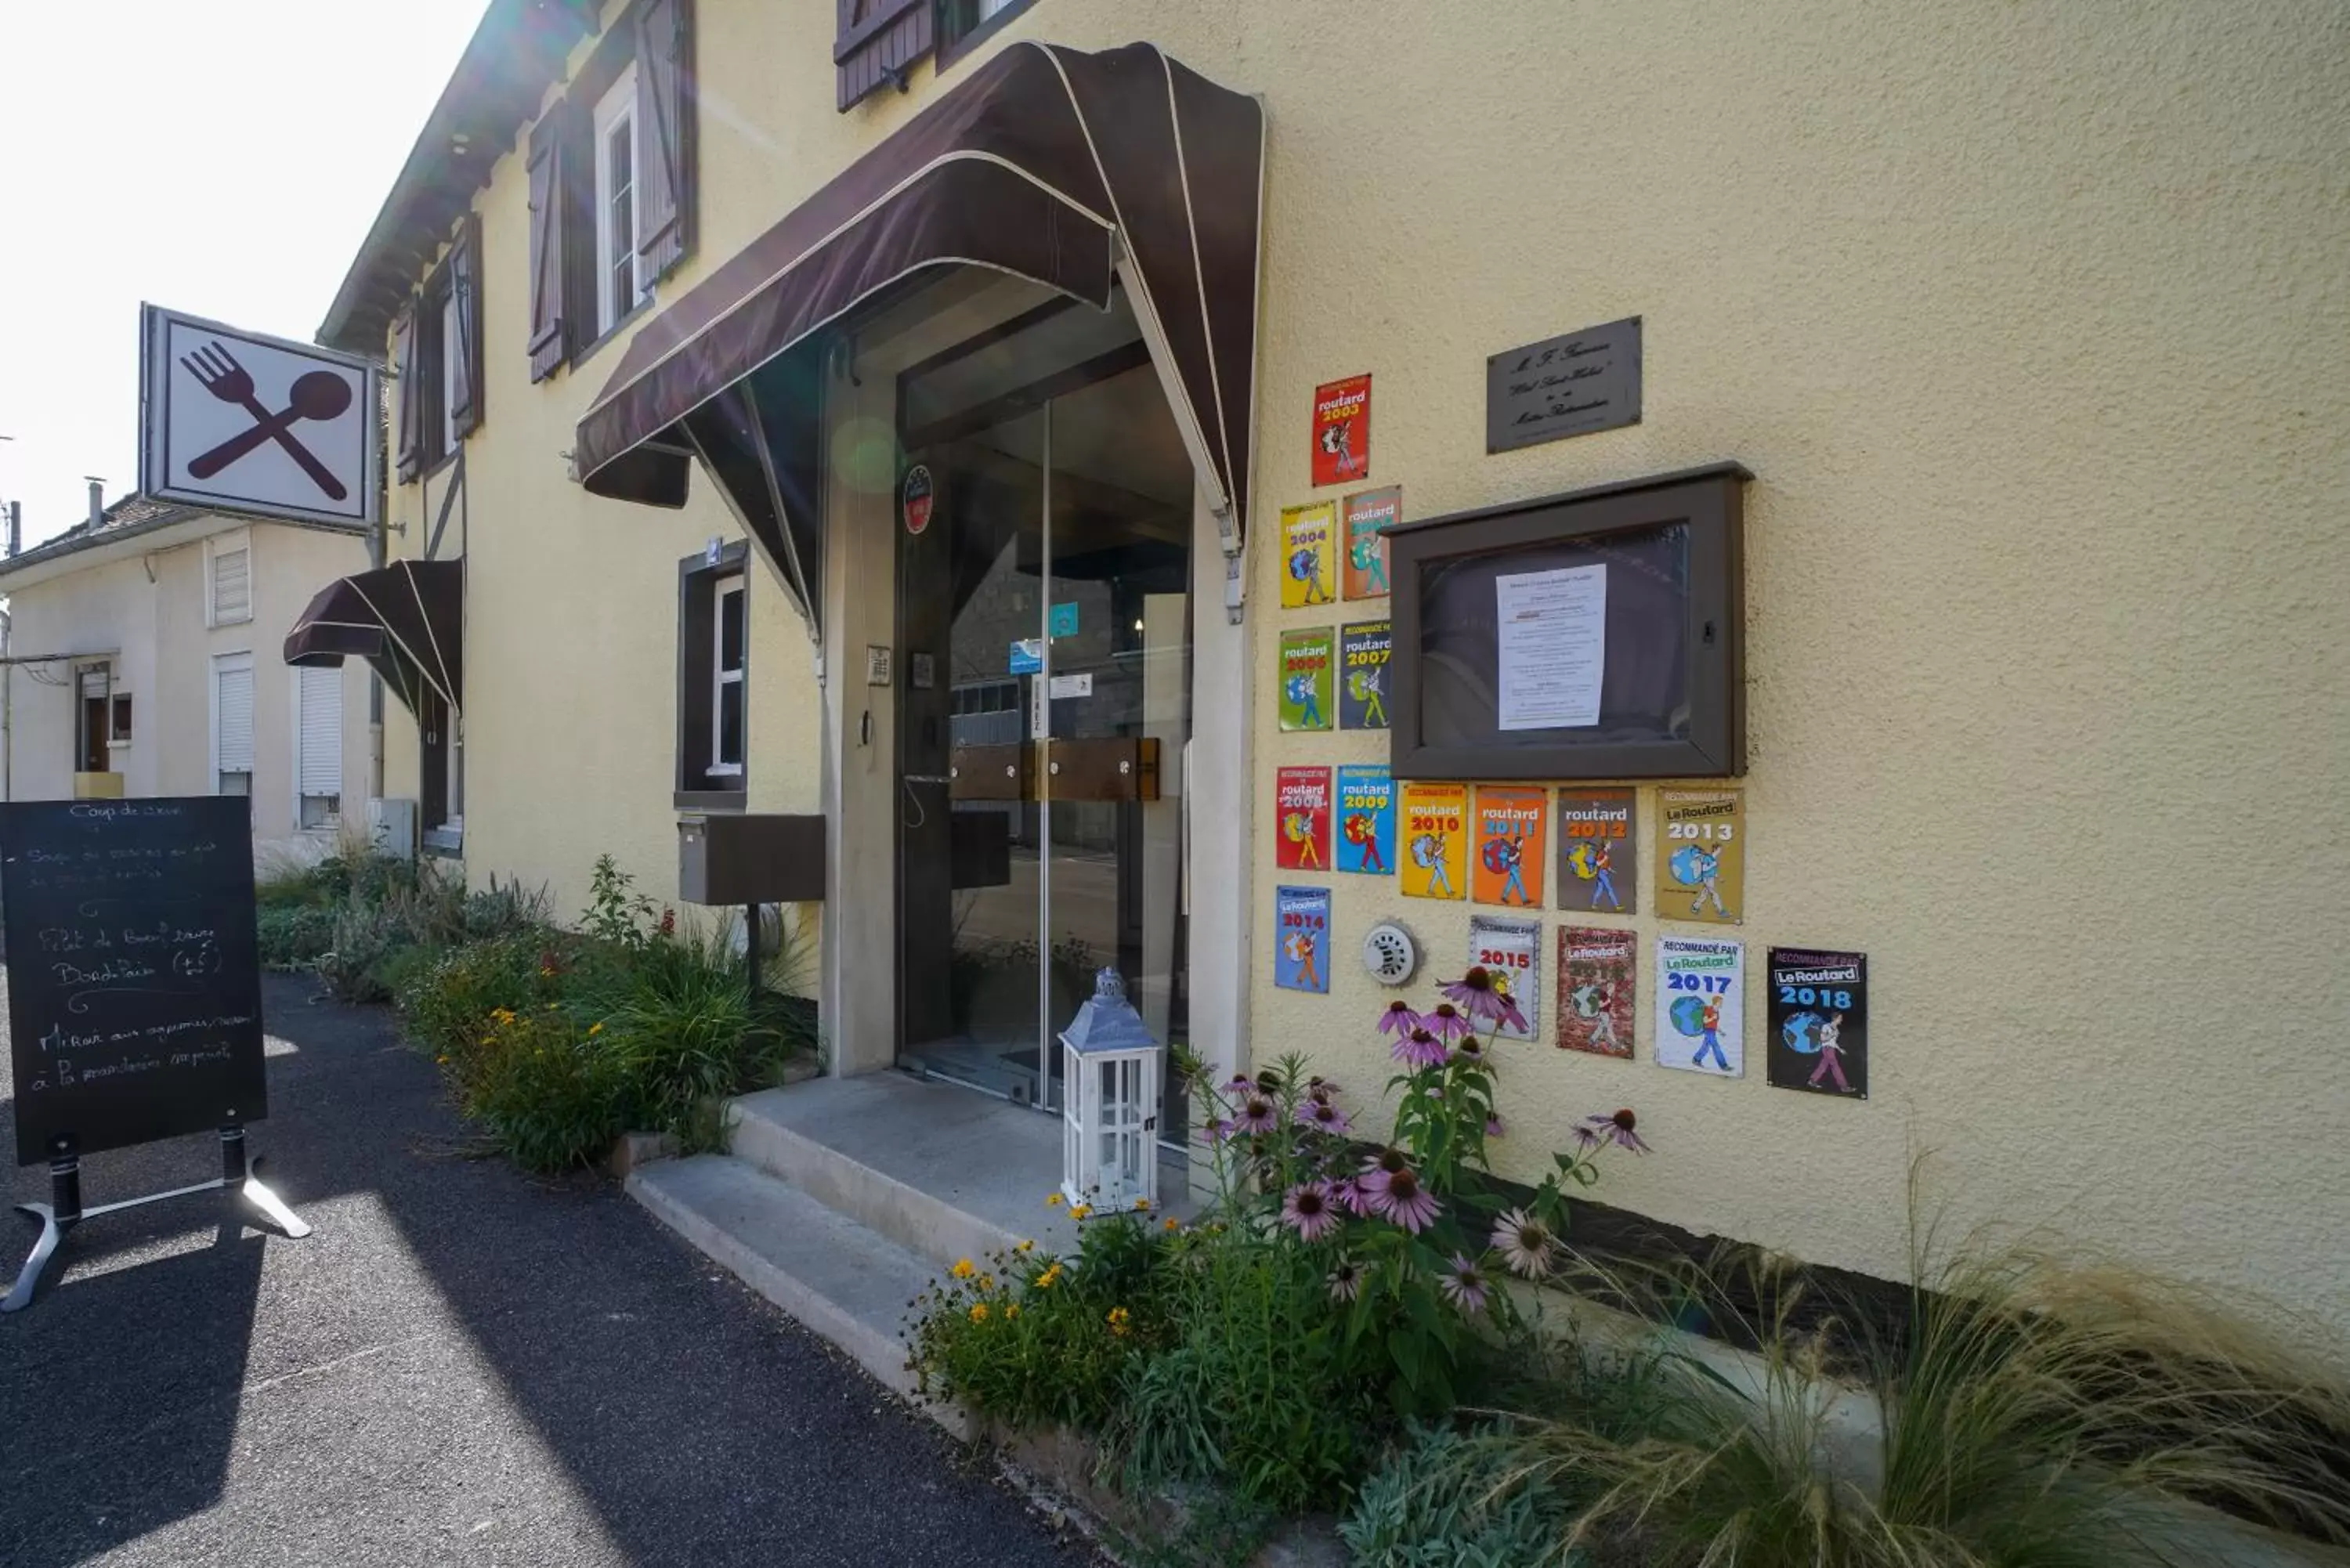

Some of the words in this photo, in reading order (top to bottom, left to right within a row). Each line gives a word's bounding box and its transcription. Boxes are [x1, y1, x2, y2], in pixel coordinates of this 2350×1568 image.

[1319, 390, 1366, 412] routard
[1322, 404, 1359, 421] 2003
[1348, 504, 1394, 522] routard
[1286, 515, 1329, 533] routard
[1290, 529, 1326, 547] 2004
[1285, 644, 1327, 658] routard
[1347, 638, 1392, 652] routard
[1347, 649, 1391, 666] 2007
[1282, 783, 1324, 795] routard
[1343, 783, 1390, 794] routard
[1344, 795, 1388, 809] 2009
[1409, 804, 1460, 815] routard
[1483, 807, 1538, 820] routard
[1566, 807, 1627, 821] routard
[1411, 816, 1459, 832] 2010
[1485, 820, 1535, 836] 2011
[1567, 821, 1626, 838] 2012
[1668, 822, 1733, 840] 2013
[1283, 913, 1325, 930] 2014
[1480, 948, 1530, 968] 2015
[1721, 945, 1738, 956] PAR
[1668, 972, 1732, 993] 2017
[1780, 986, 1852, 1010] 2018
